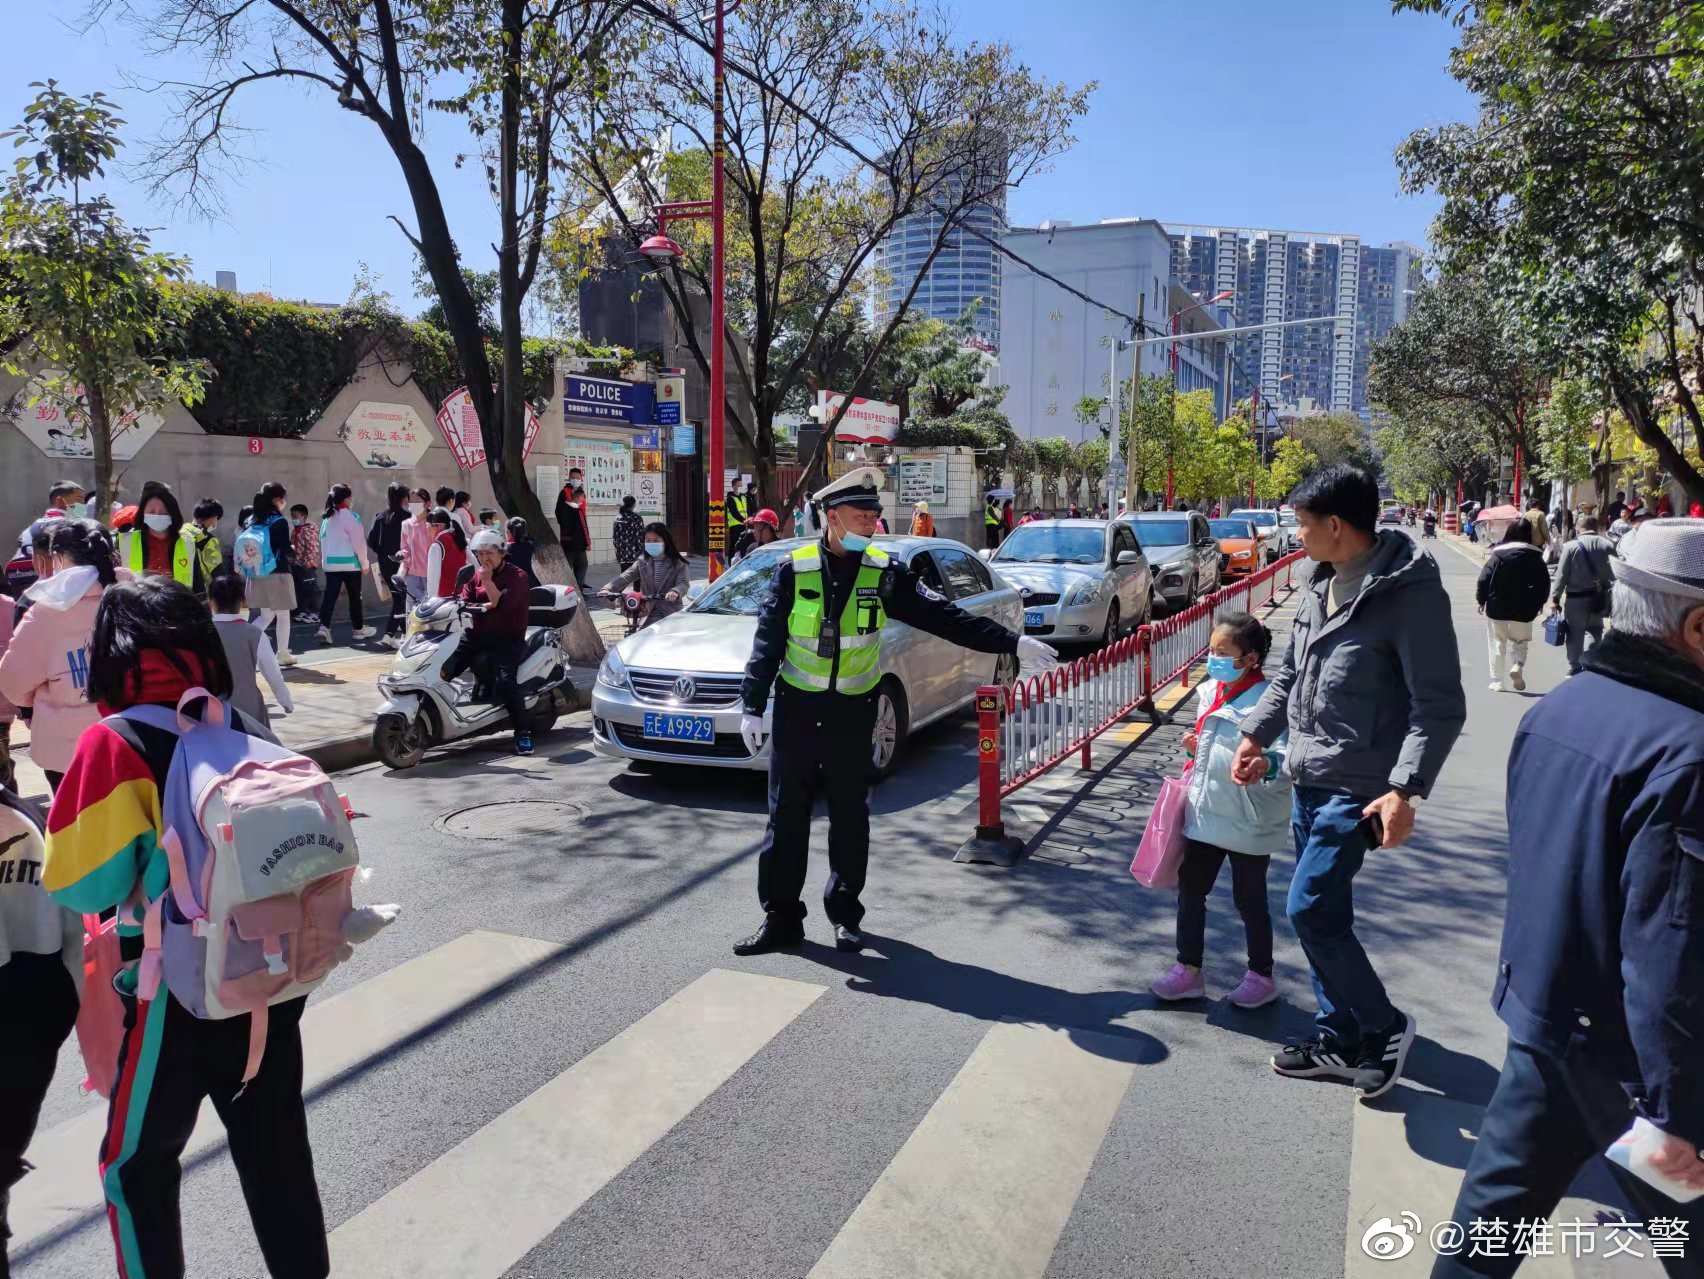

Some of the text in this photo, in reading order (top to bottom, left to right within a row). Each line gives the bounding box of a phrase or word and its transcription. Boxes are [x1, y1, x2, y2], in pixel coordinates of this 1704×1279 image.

[580, 383, 621, 401] POLICE
[357, 429, 417, 443] 敬业奉献
[252, 439, 259, 453] 3
[260, 833, 344, 876] FASHION BAG
